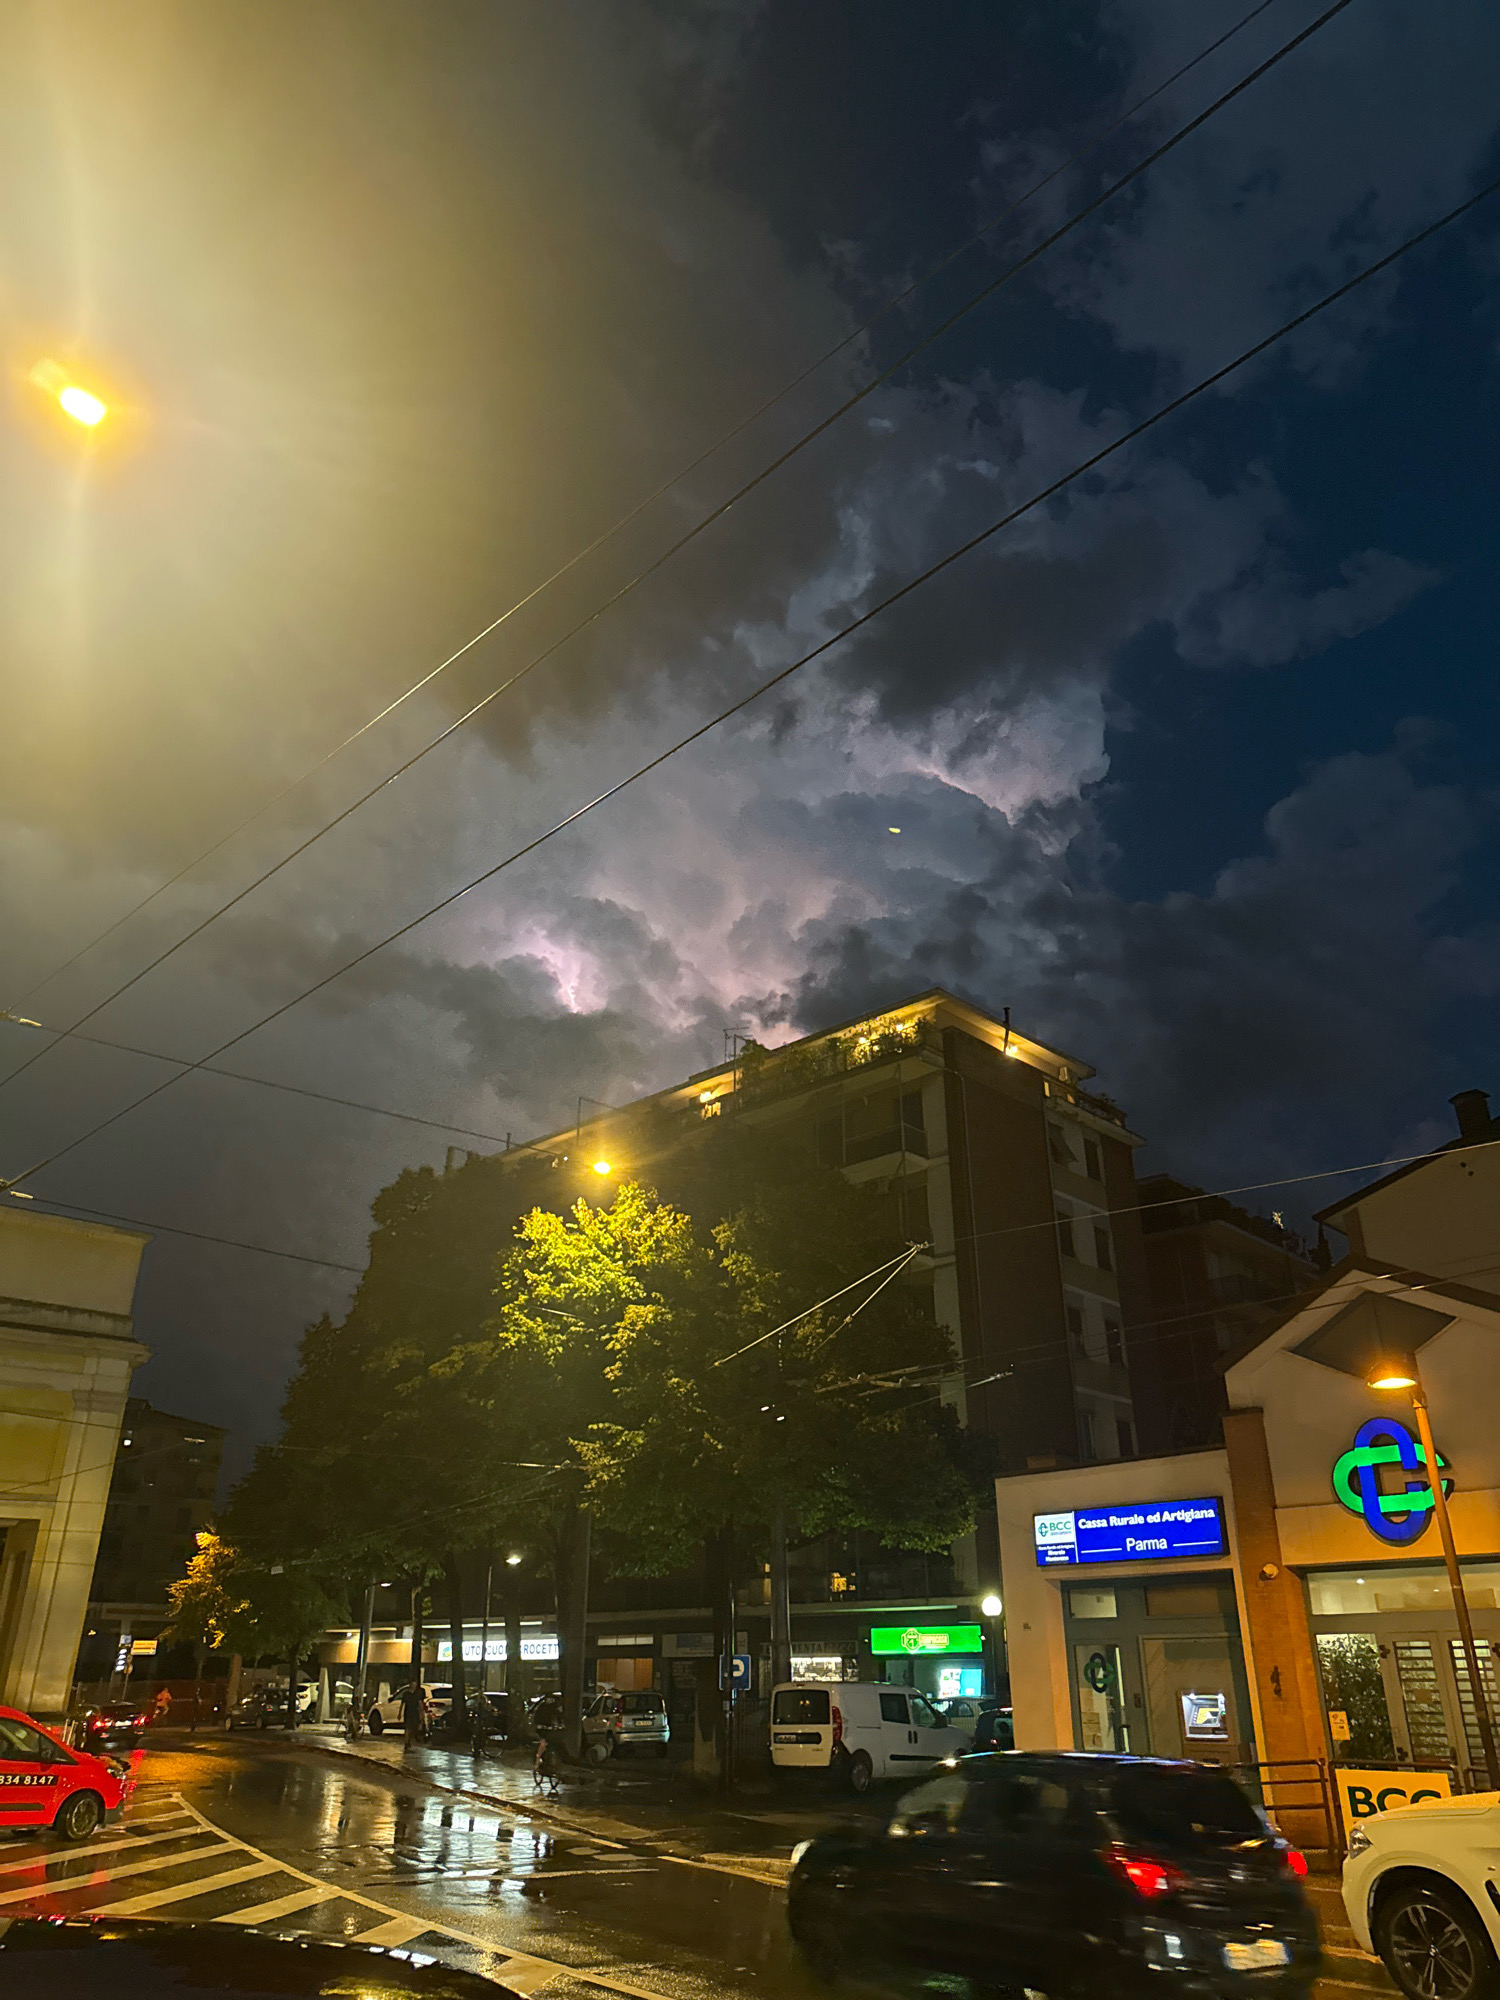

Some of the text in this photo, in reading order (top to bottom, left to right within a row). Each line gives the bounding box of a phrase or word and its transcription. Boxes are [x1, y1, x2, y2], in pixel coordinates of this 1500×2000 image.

[1078, 1509, 1216, 1529] Cassa Rurale ed Artigiana
[1049, 1521, 1072, 1531] BCC
[1126, 1538, 1168, 1551] Parma
[24, 1775, 54, 1785] 8147
